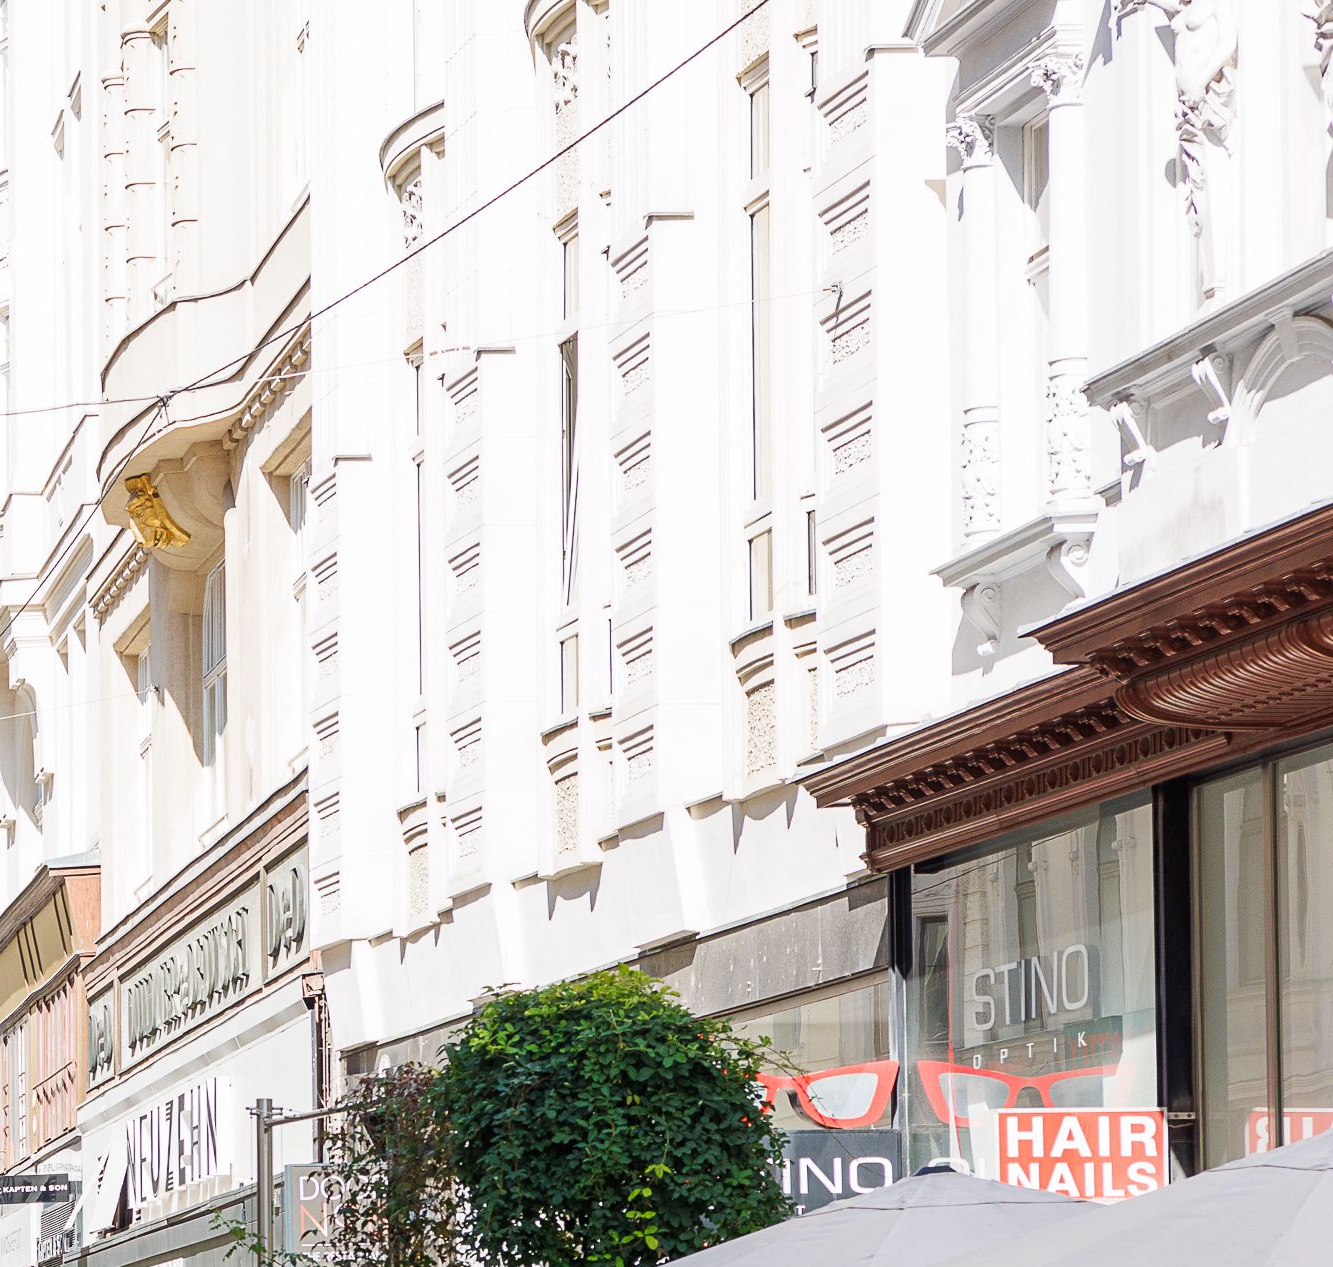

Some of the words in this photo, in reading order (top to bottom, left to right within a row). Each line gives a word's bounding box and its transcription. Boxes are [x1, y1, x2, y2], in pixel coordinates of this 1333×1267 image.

[973, 944, 1090, 1031] STINO
[972, 1031, 1088, 1070] OPTIK
[1006, 1115, 1158, 1158] HAIR
[3, 1186, 38, 1194] KAPTEN
[766, 1156, 893, 1194] INO
[1006, 1161, 1158, 1198] NAILS
